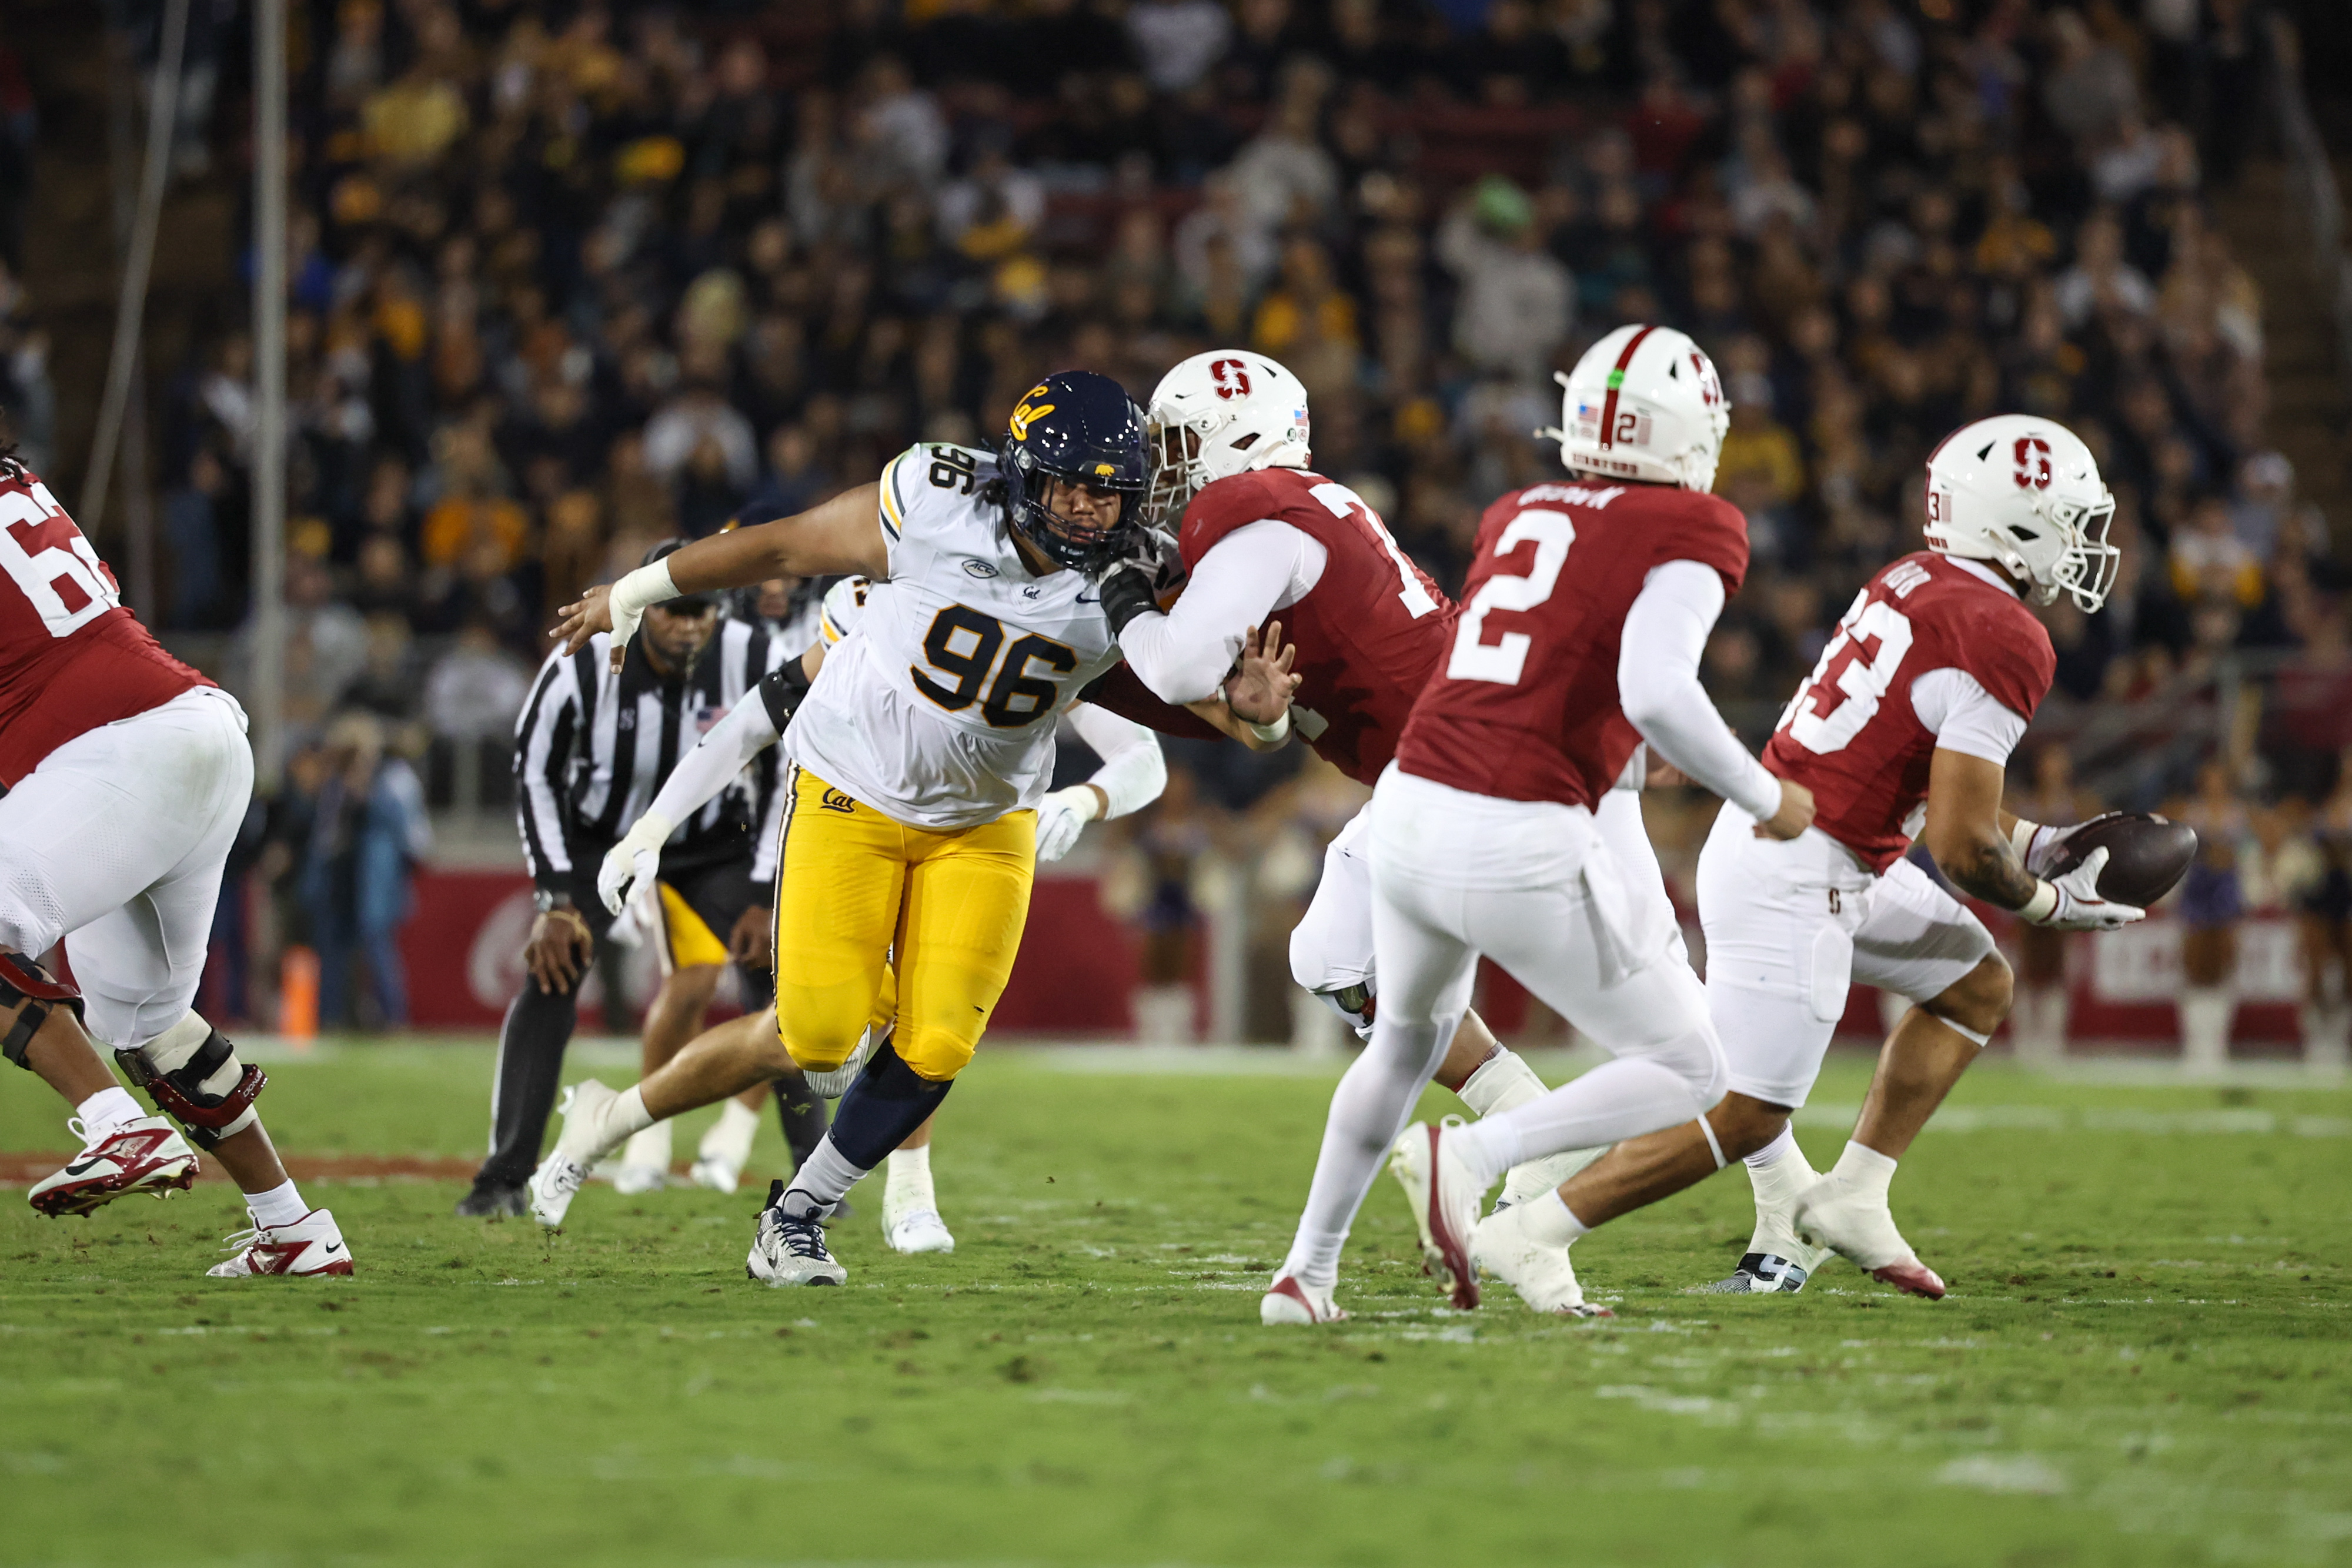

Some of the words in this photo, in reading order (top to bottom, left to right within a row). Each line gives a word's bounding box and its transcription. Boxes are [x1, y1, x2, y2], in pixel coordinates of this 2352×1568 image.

[1618, 413, 1636, 443] 2
[929, 446, 975, 496] 96
[967, 562, 993, 574] ACC
[1023, 586, 1040, 599] Cal
[1446, 509, 1576, 686] 2
[909, 603, 1080, 728] 96
